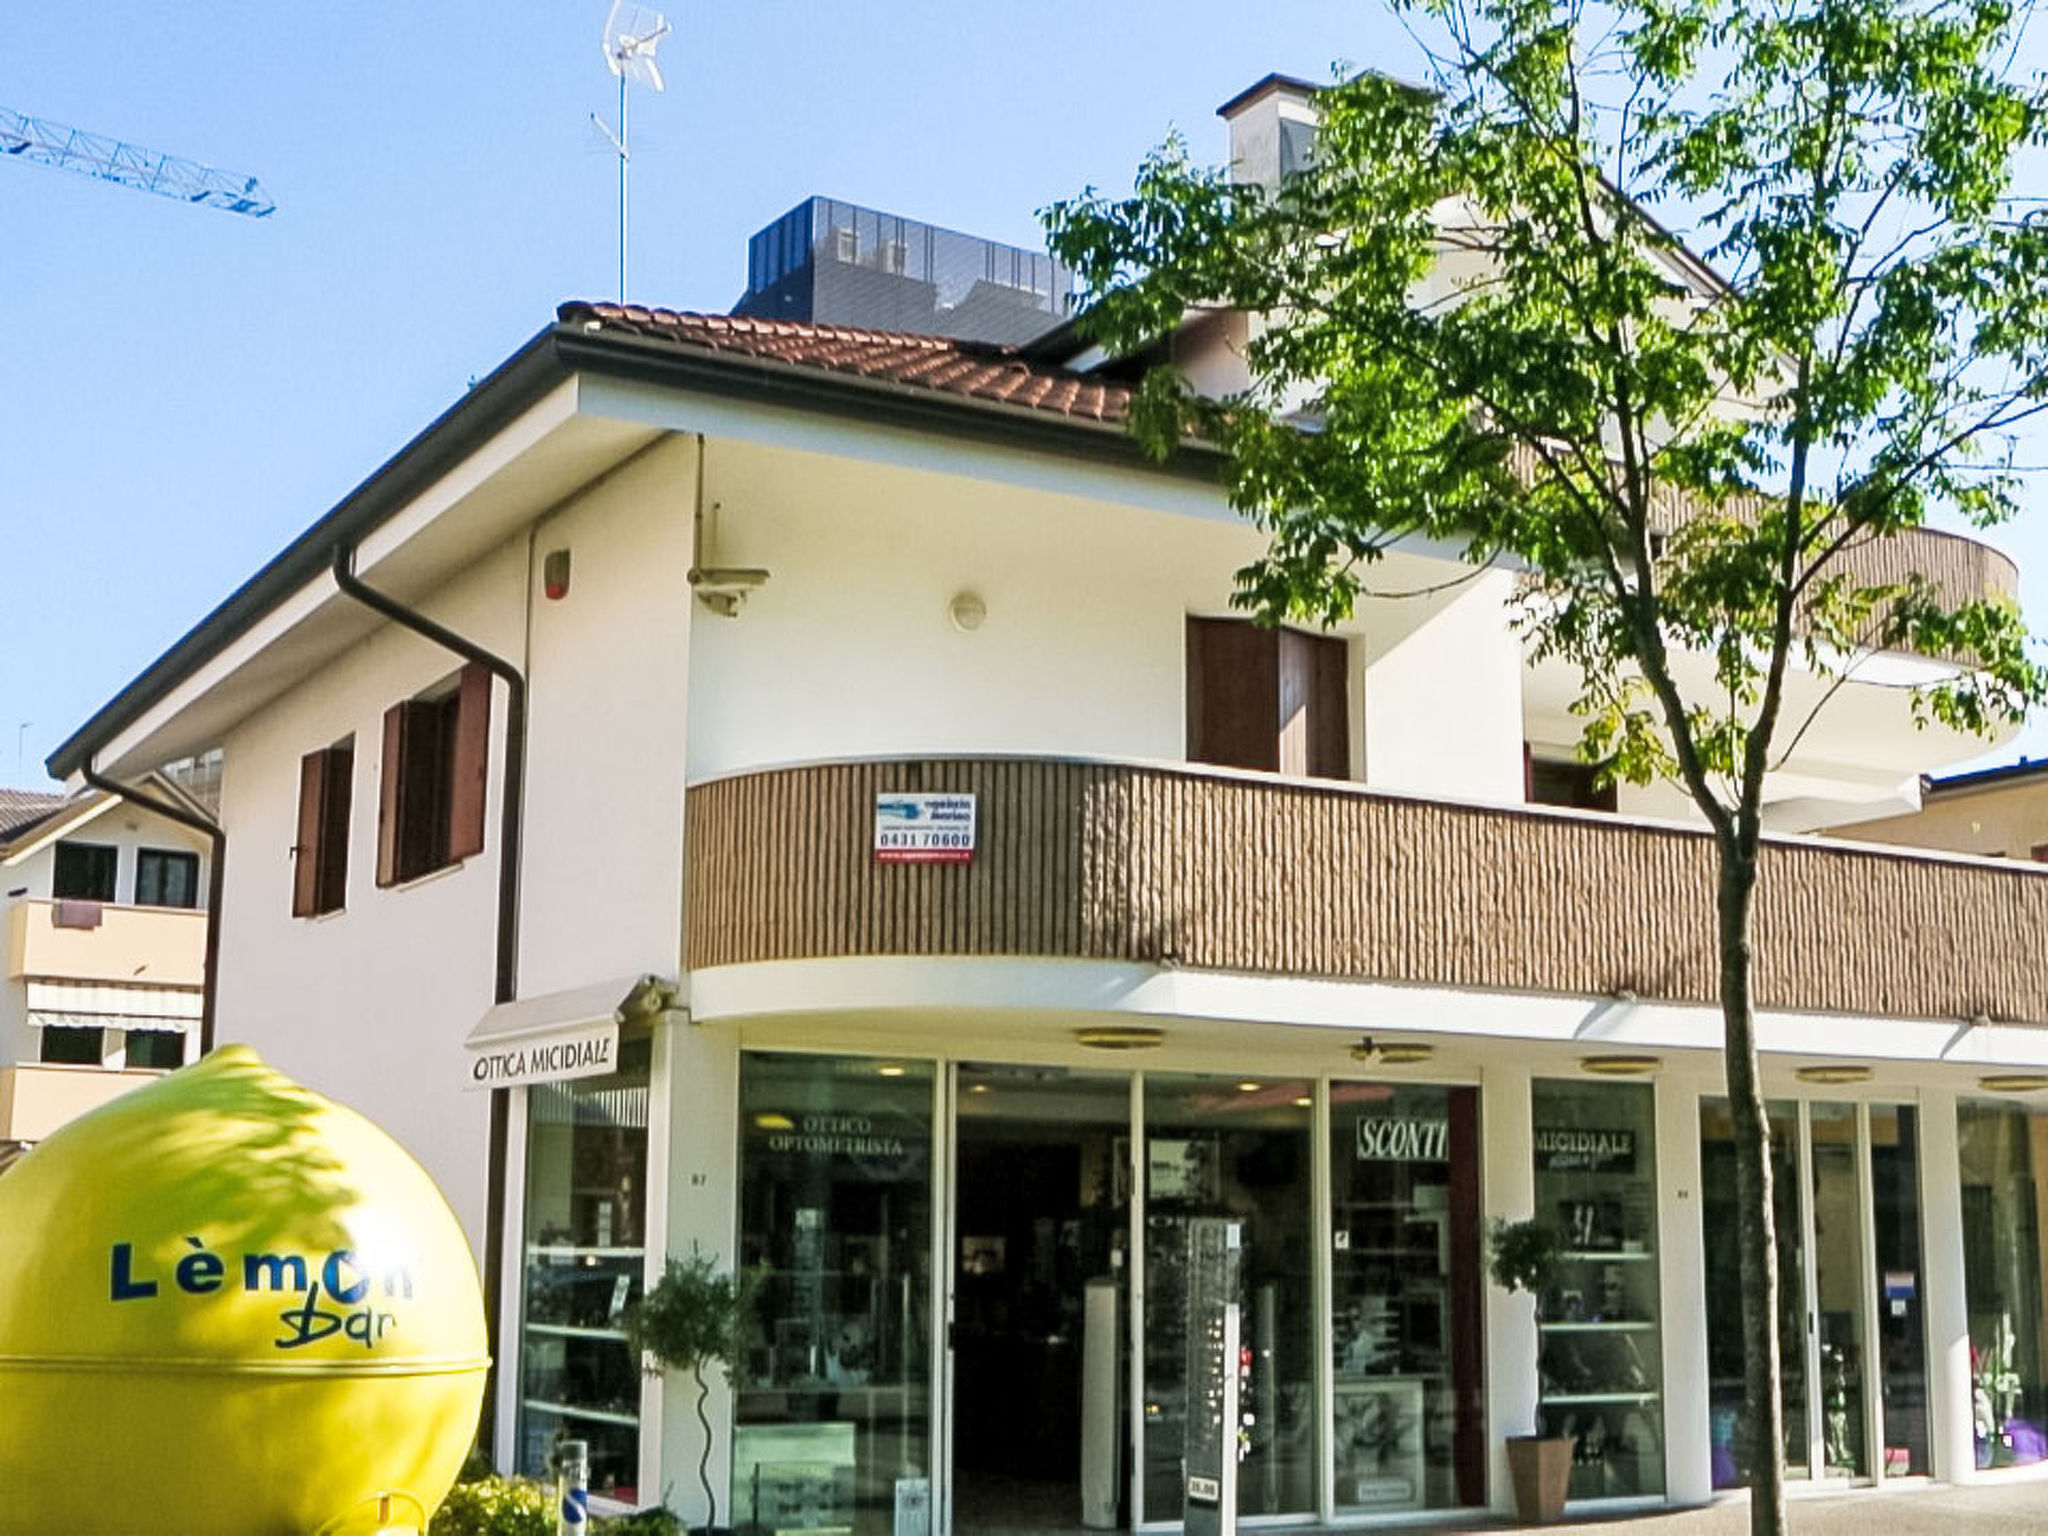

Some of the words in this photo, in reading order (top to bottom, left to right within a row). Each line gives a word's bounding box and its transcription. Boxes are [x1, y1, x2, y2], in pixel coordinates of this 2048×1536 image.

[881, 834, 917, 846] 0431
[473, 1051, 526, 1080] OTTICA
[531, 1038, 610, 1074] MICIDIALE
[803, 1115, 872, 1133] OTTICO
[1360, 1119, 1446, 1158] SCONTI
[769, 1135, 903, 1155] OPTOMETRISTA
[275, 1281, 396, 1348] bar
